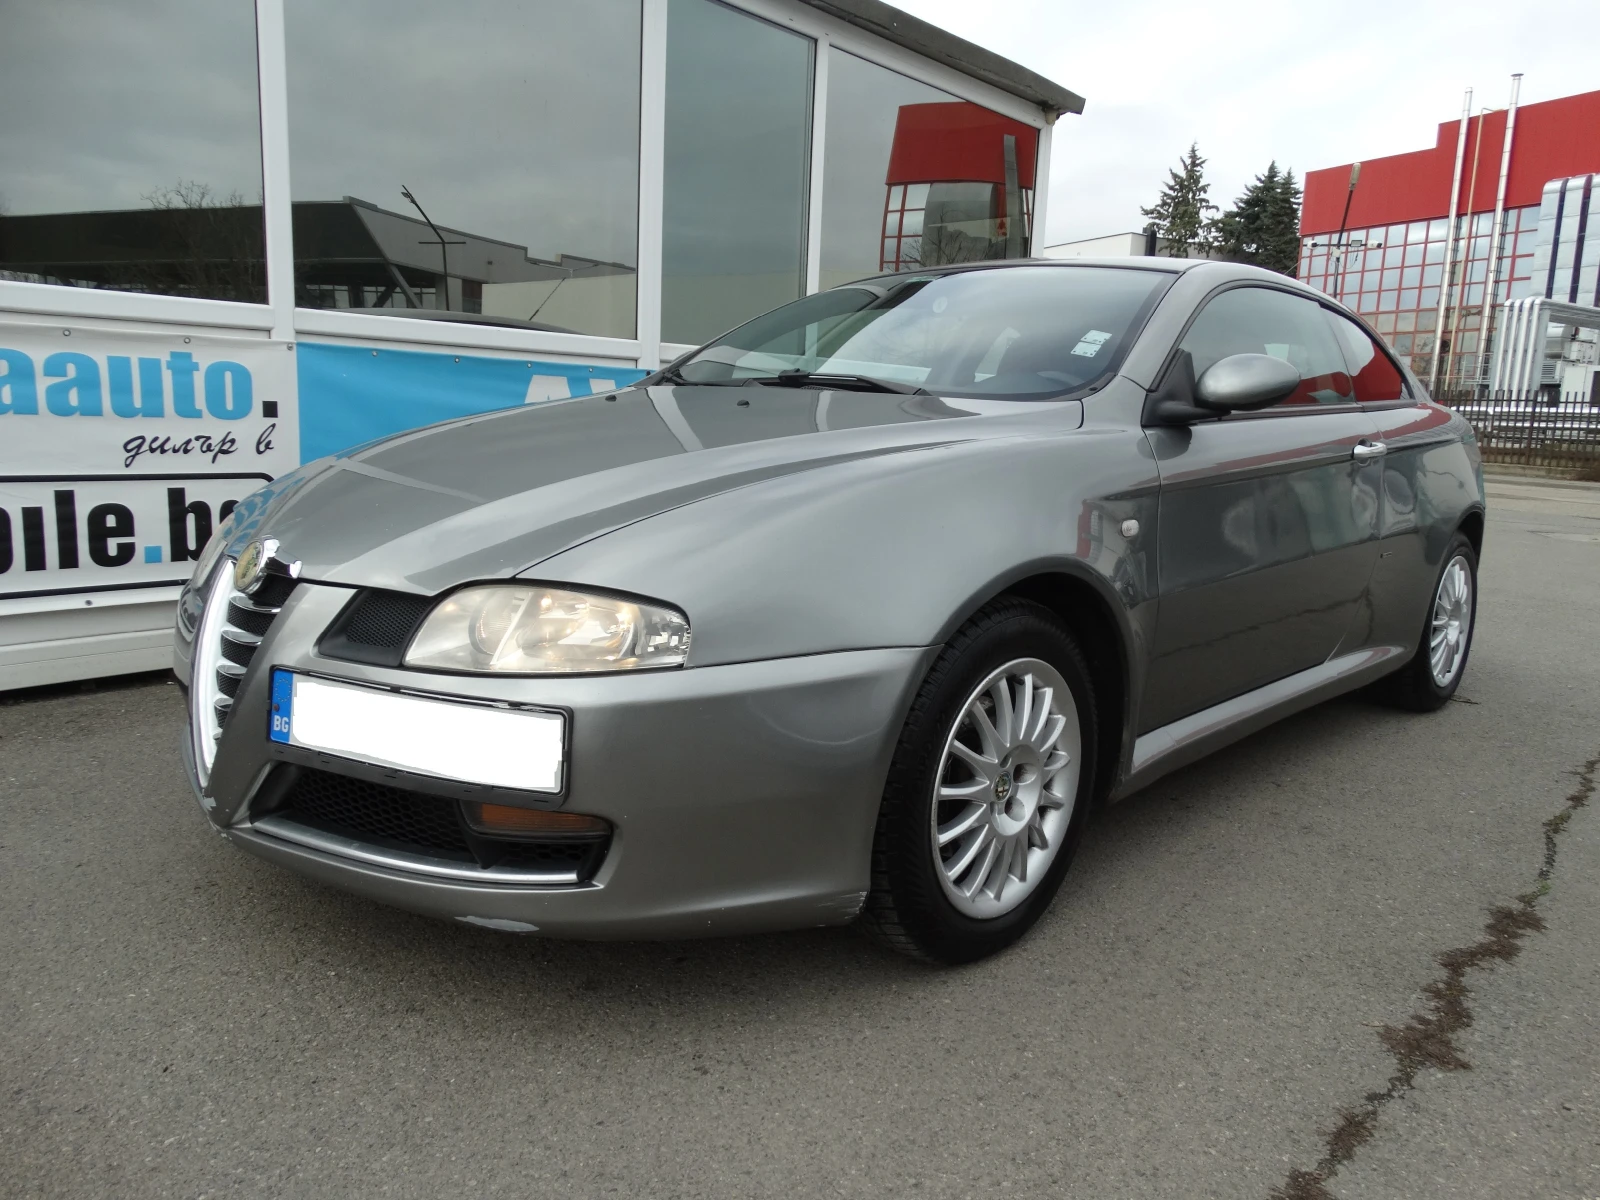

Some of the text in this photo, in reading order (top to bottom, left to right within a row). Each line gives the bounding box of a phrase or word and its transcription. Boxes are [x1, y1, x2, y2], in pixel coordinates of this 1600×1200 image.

[123, 423, 277, 468] дилър в
[273, 714, 289, 733] BG
